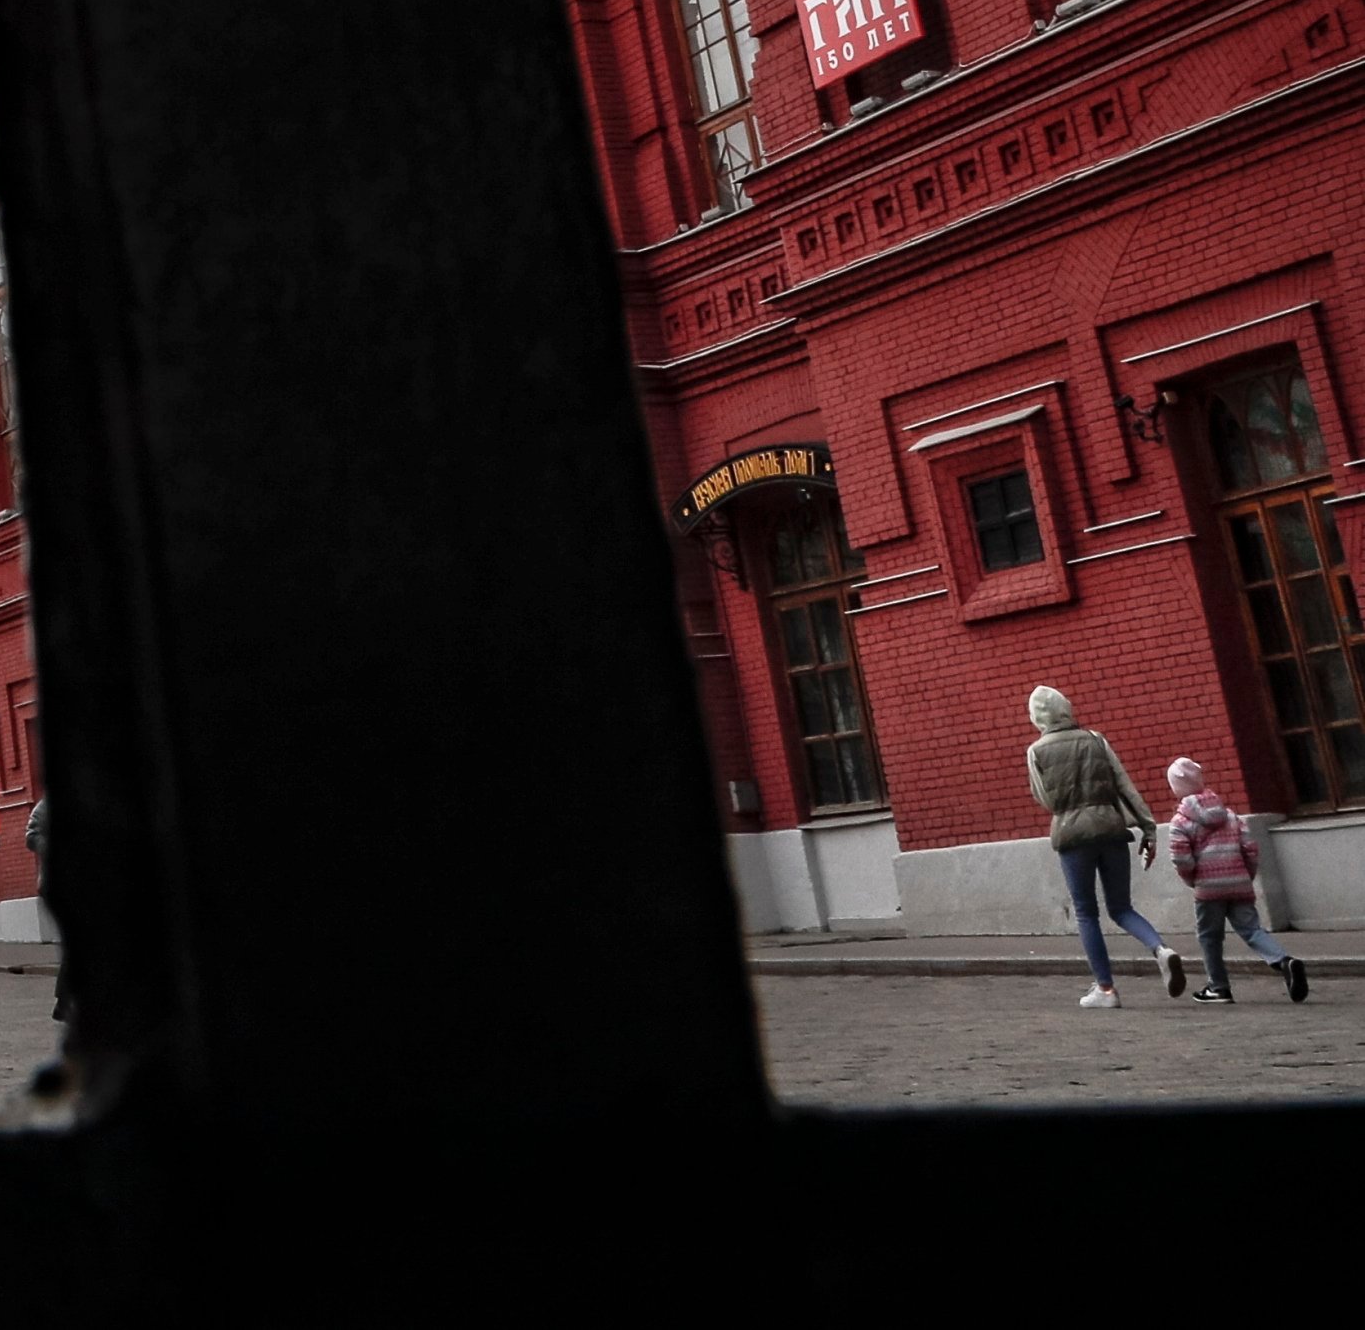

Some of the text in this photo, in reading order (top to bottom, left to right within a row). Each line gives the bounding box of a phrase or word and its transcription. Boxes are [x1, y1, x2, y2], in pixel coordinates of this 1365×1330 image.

[815, 11, 911, 76] 150 ЛЕТ
[808, 451, 815, 476] 1
